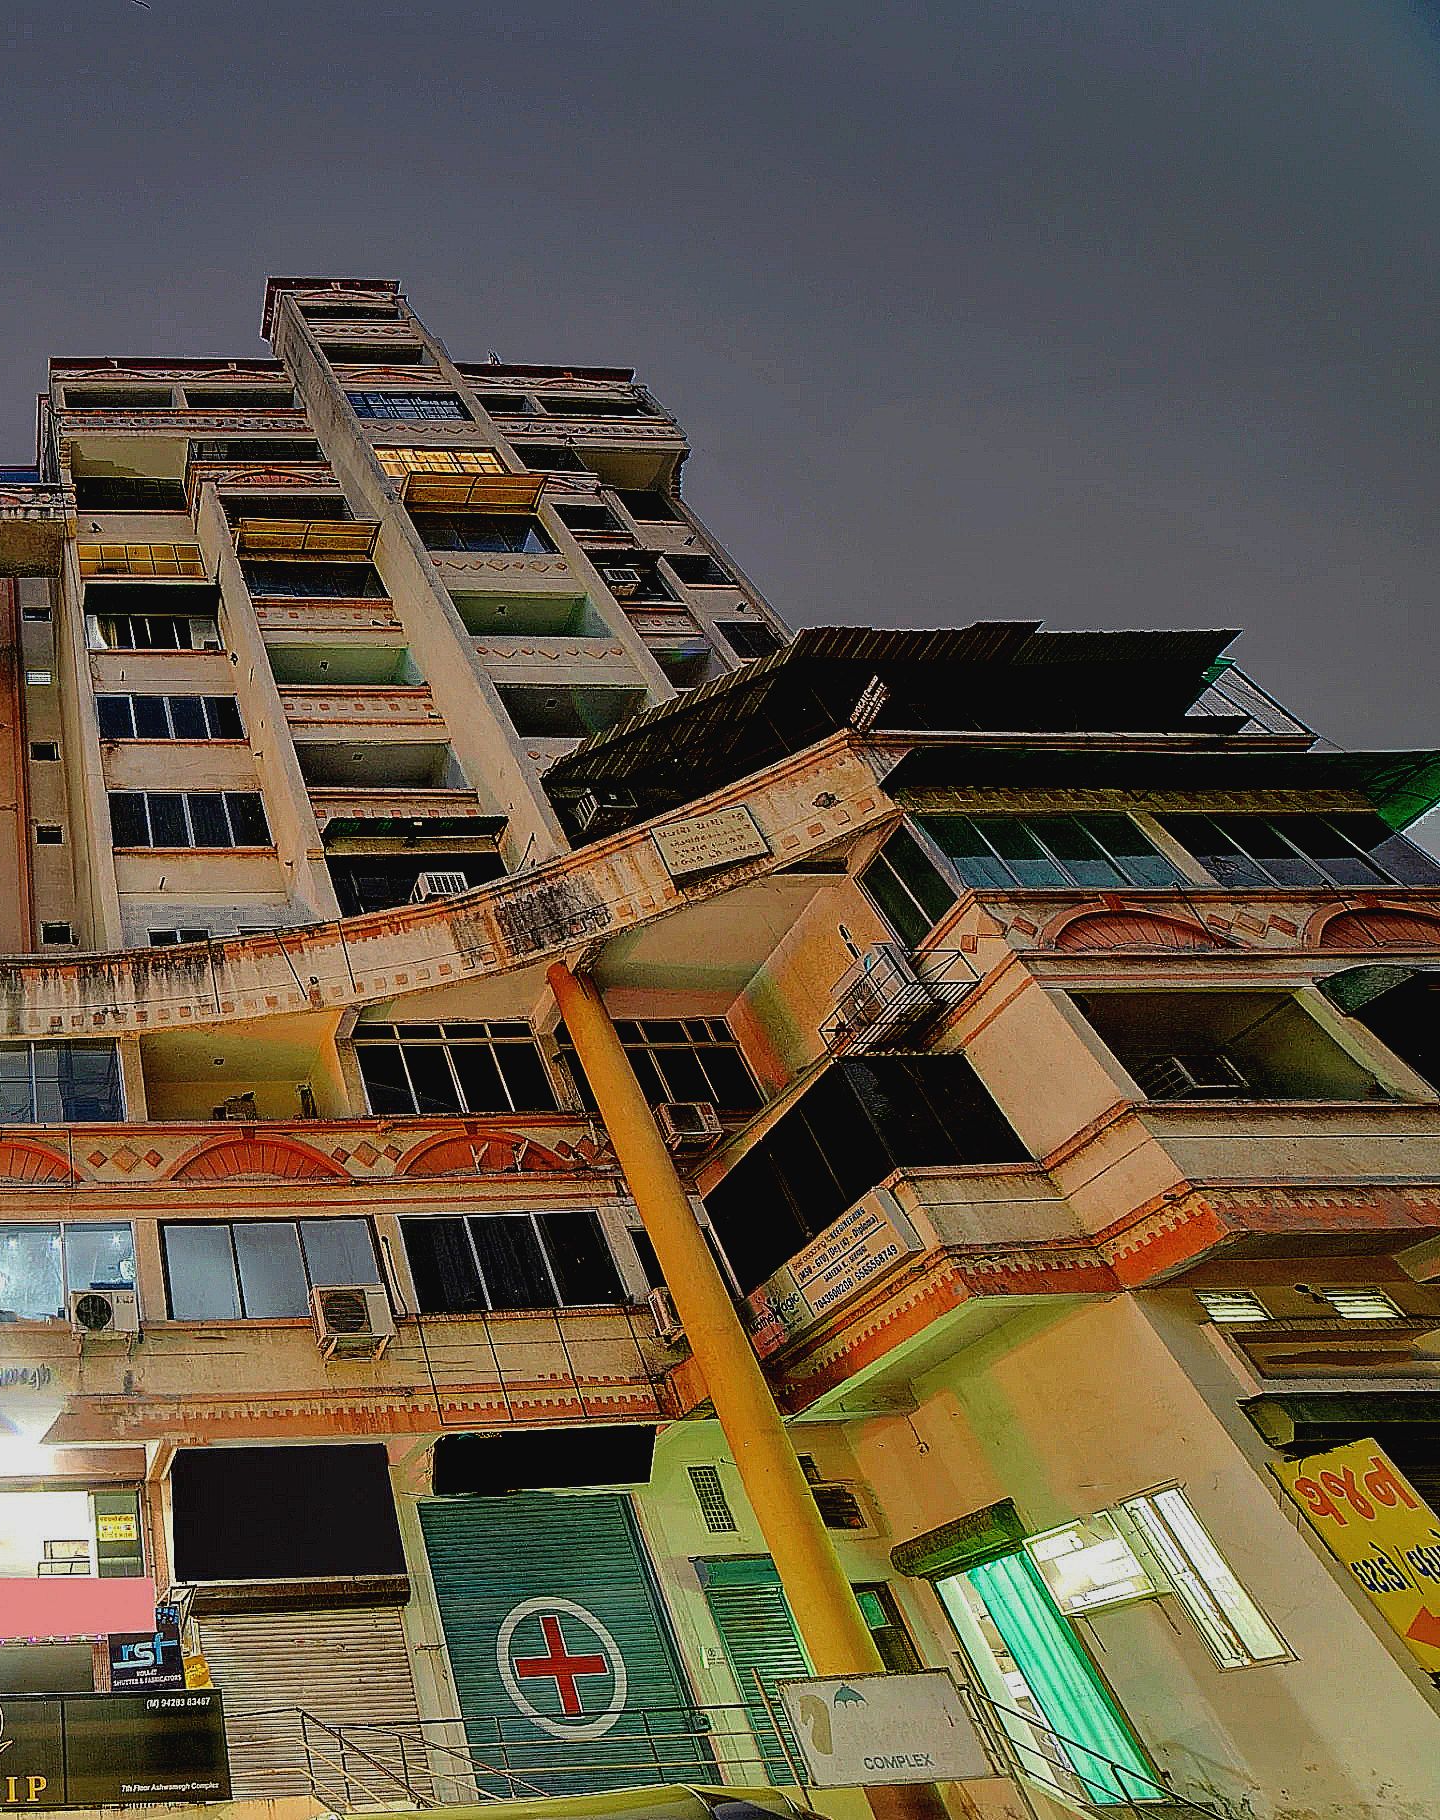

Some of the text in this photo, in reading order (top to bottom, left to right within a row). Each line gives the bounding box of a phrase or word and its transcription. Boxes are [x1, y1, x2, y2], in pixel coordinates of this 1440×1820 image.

[113, 1632, 178, 1669] rsf
[863, 1753, 935, 1770] COMPLEX
[133, 1783, 150, 1793] Floor
